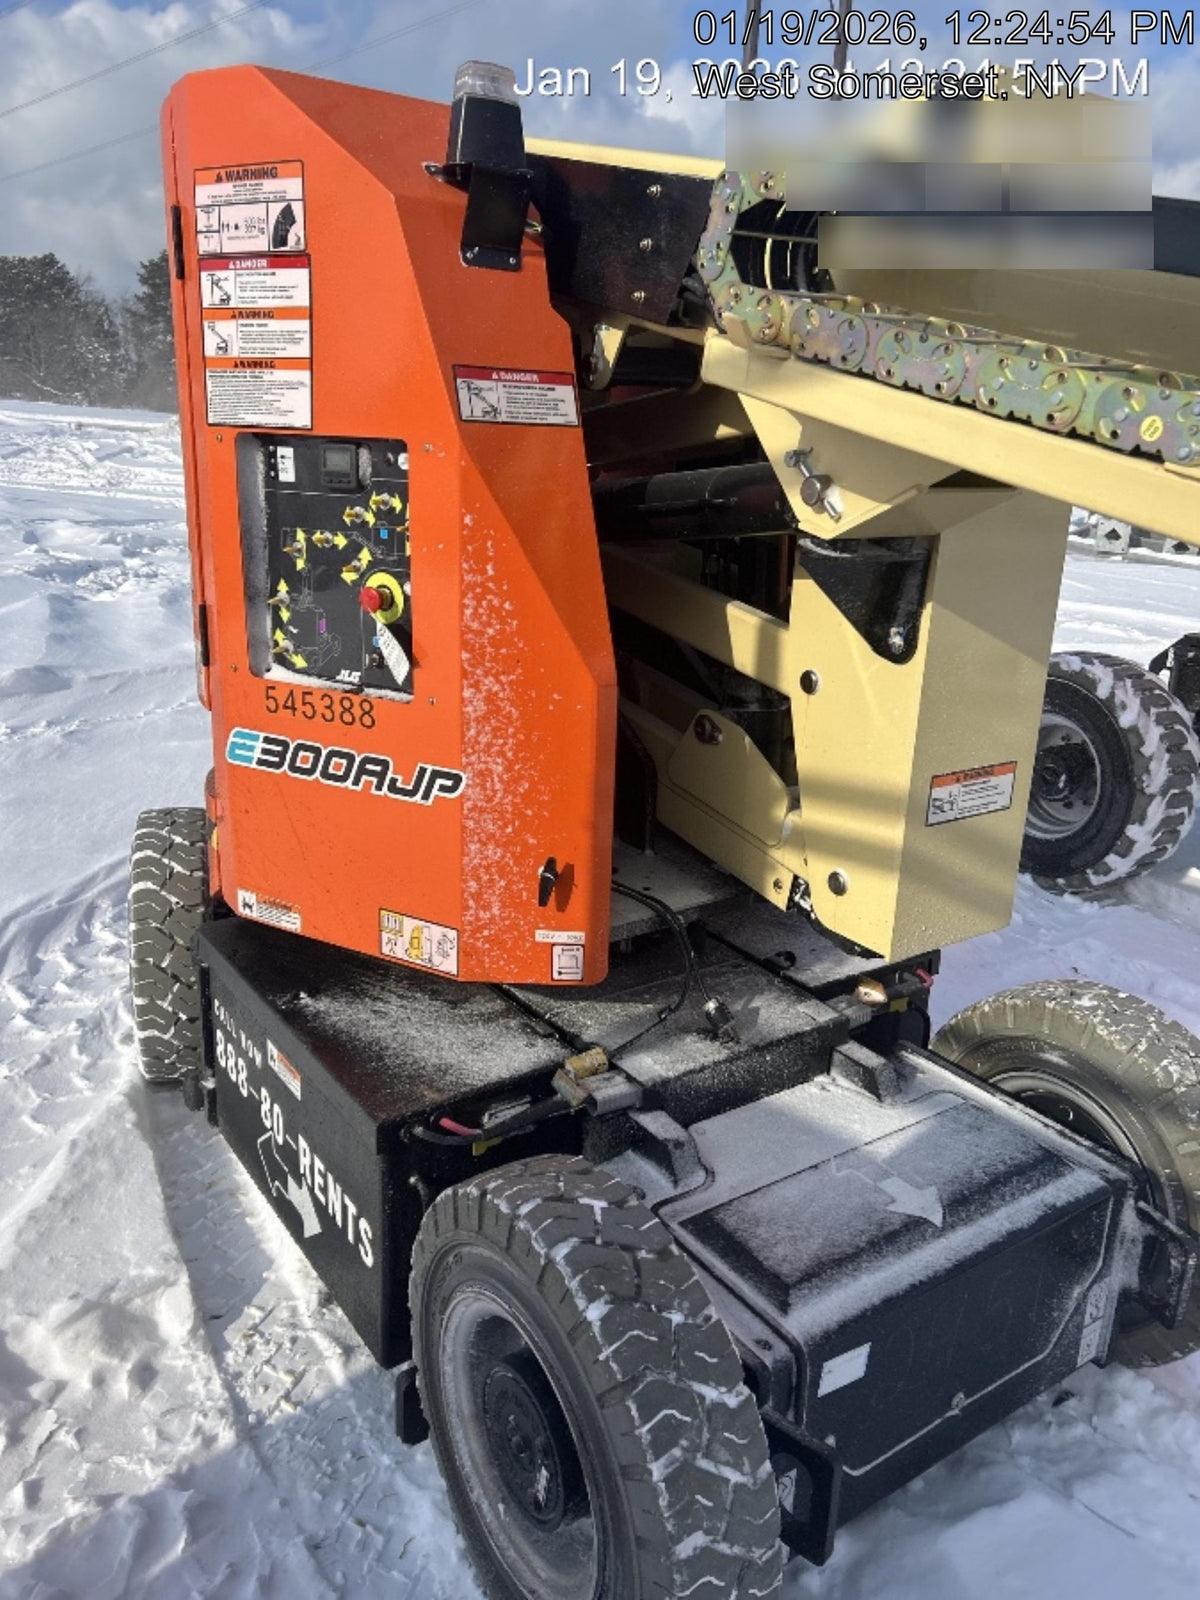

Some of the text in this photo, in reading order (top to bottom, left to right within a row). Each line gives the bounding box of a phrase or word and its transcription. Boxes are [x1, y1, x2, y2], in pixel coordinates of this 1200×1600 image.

[225, 166, 279, 182] WARNING
[500, 371, 540, 382] DANGER
[265, 686, 376, 729] 545388
[226, 727, 466, 805] E300AJP
[215, 1028, 375, 1269] 888-80-RENTS
